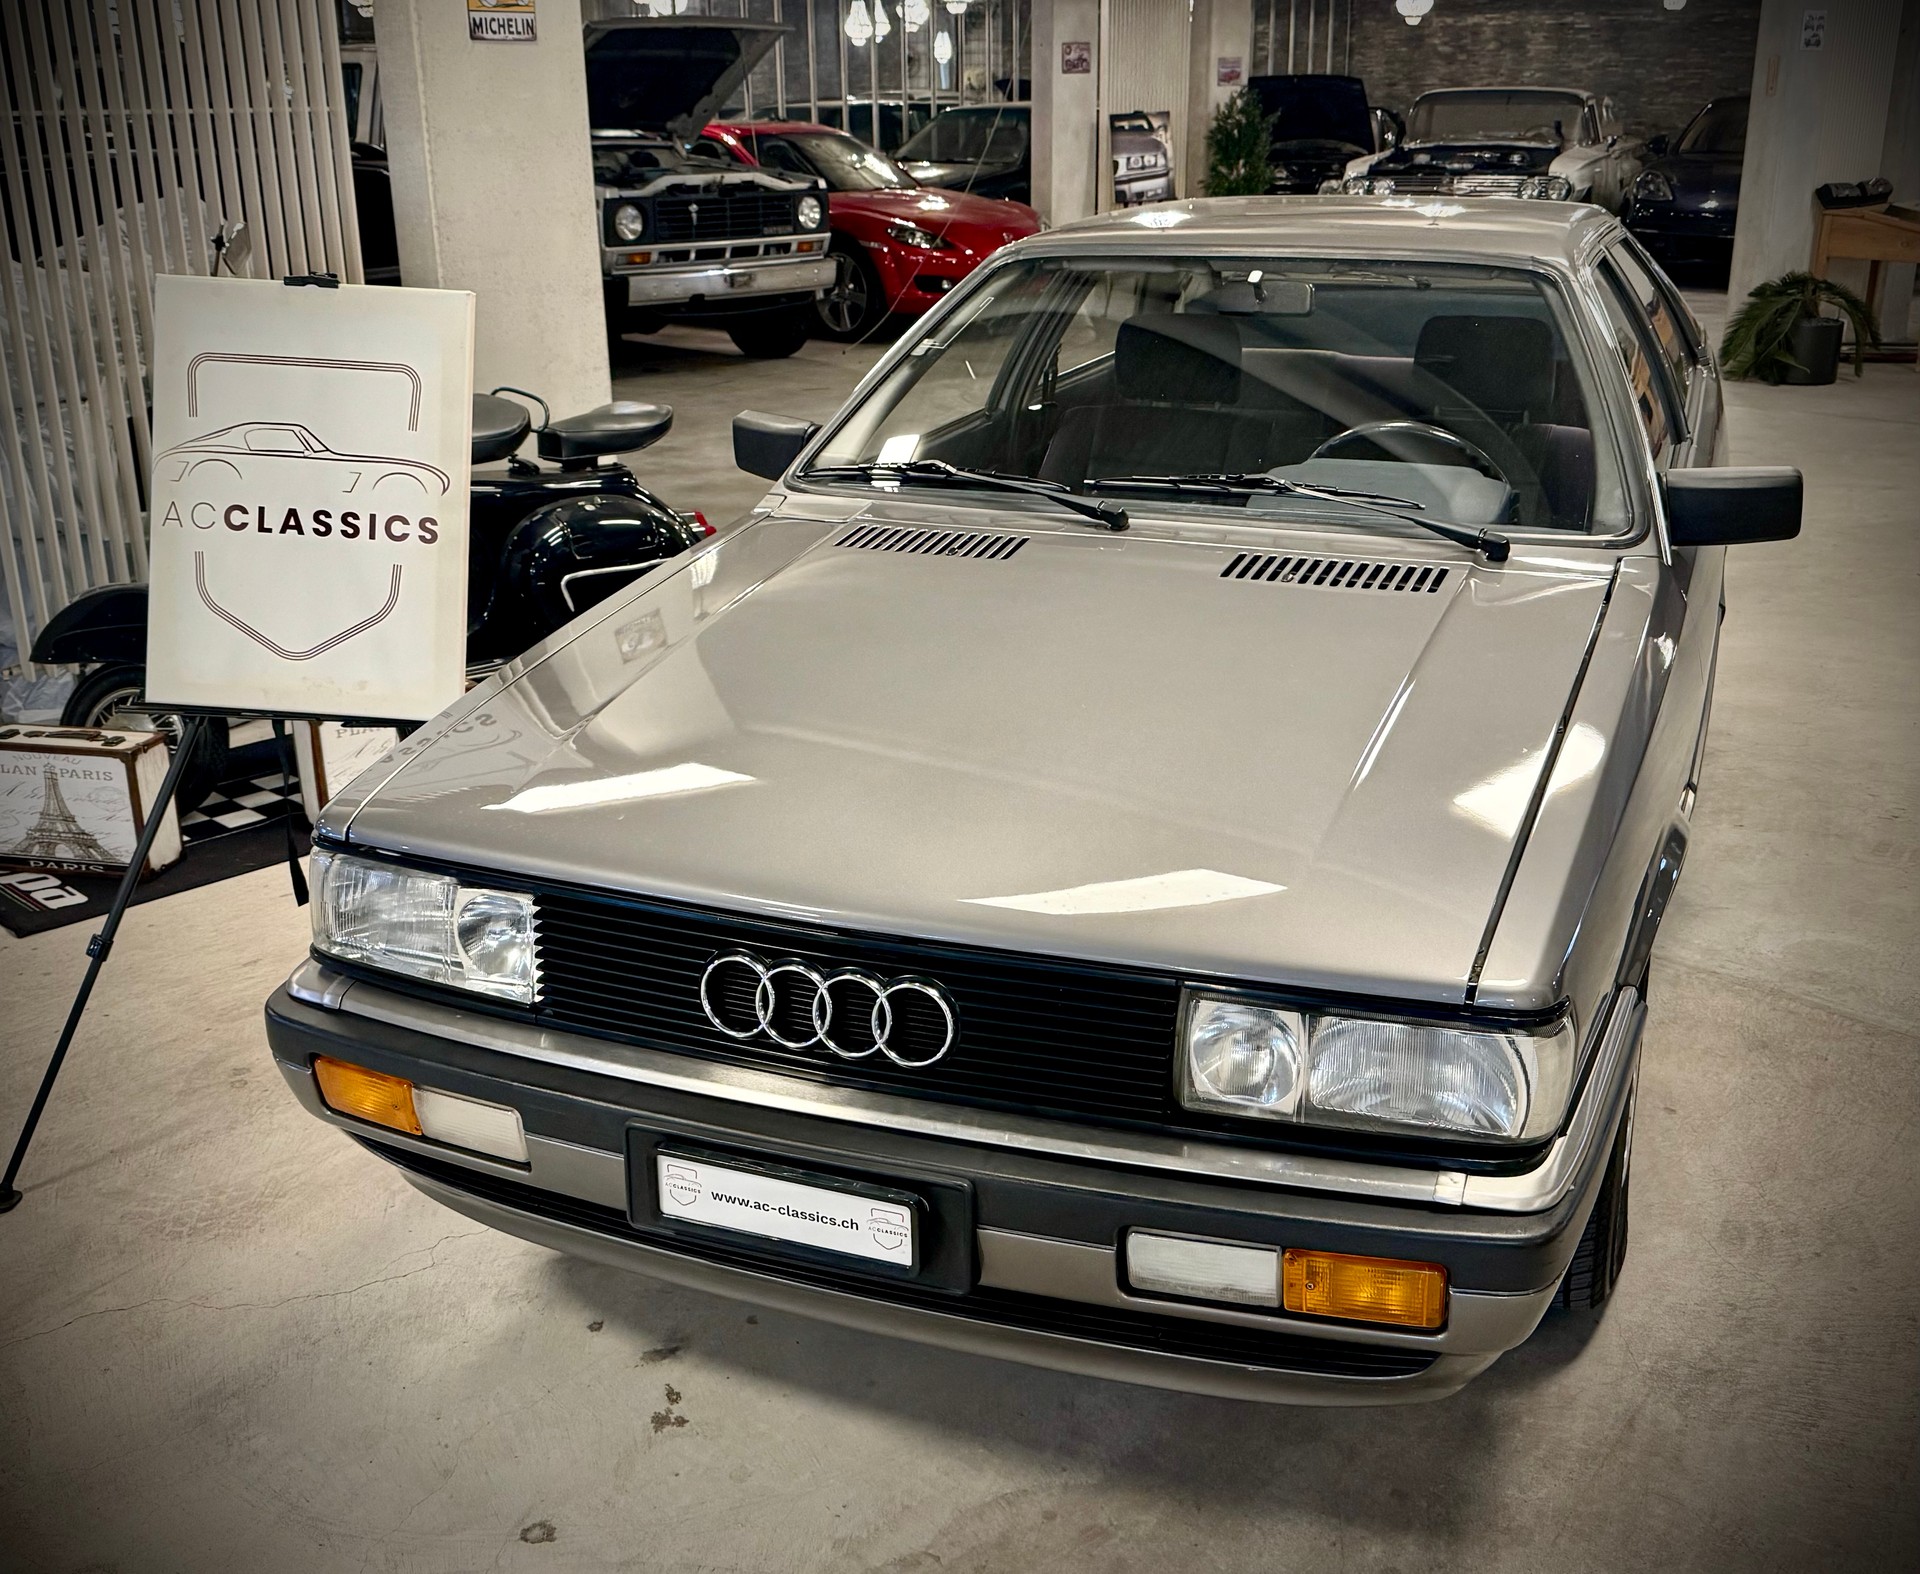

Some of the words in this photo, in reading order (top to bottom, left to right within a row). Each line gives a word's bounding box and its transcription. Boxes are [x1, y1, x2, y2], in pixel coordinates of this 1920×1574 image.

[472, 16, 535, 35] MICHELIN
[59, 767, 114, 782] PARIS
[711, 1190, 860, 1232] www.ac-classics.ch
